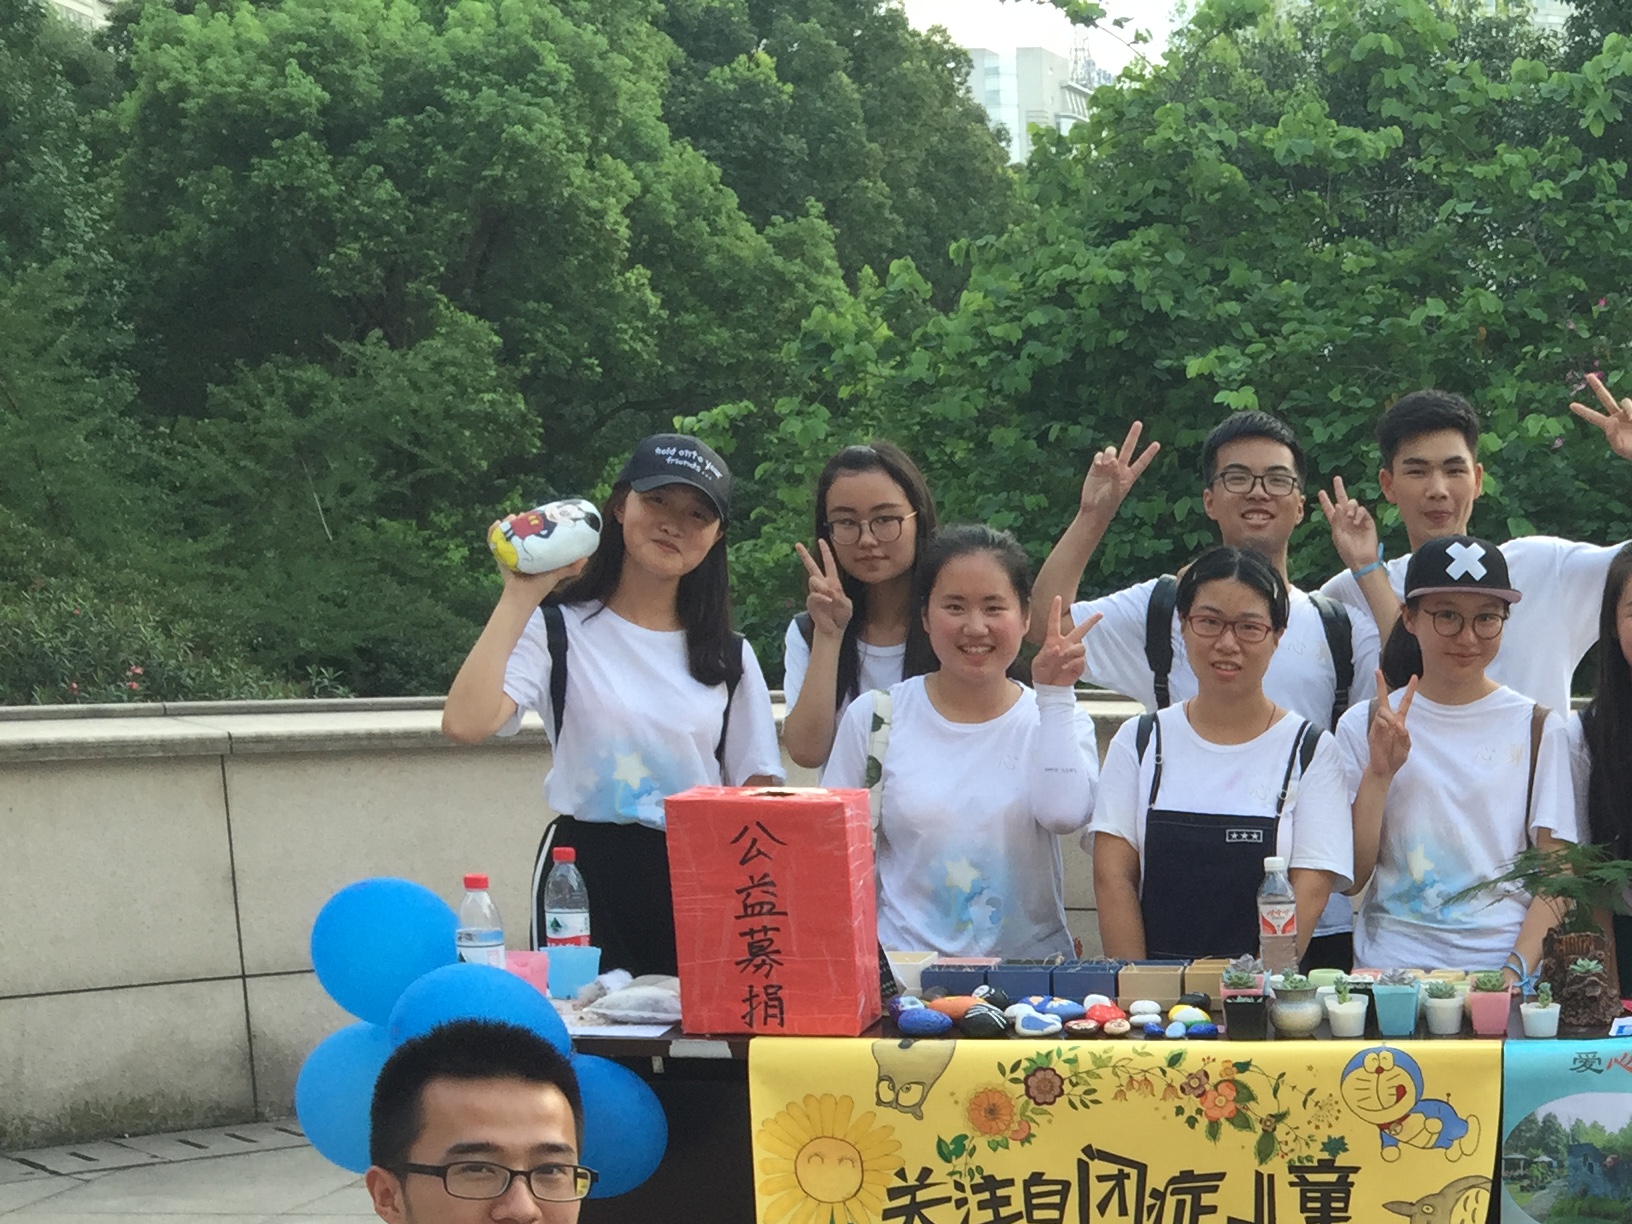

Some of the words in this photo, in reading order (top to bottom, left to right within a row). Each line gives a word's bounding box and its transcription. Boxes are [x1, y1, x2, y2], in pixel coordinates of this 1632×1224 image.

[654, 446, 677, 456] hold
[729, 820, 789, 1028] 公益募捐
